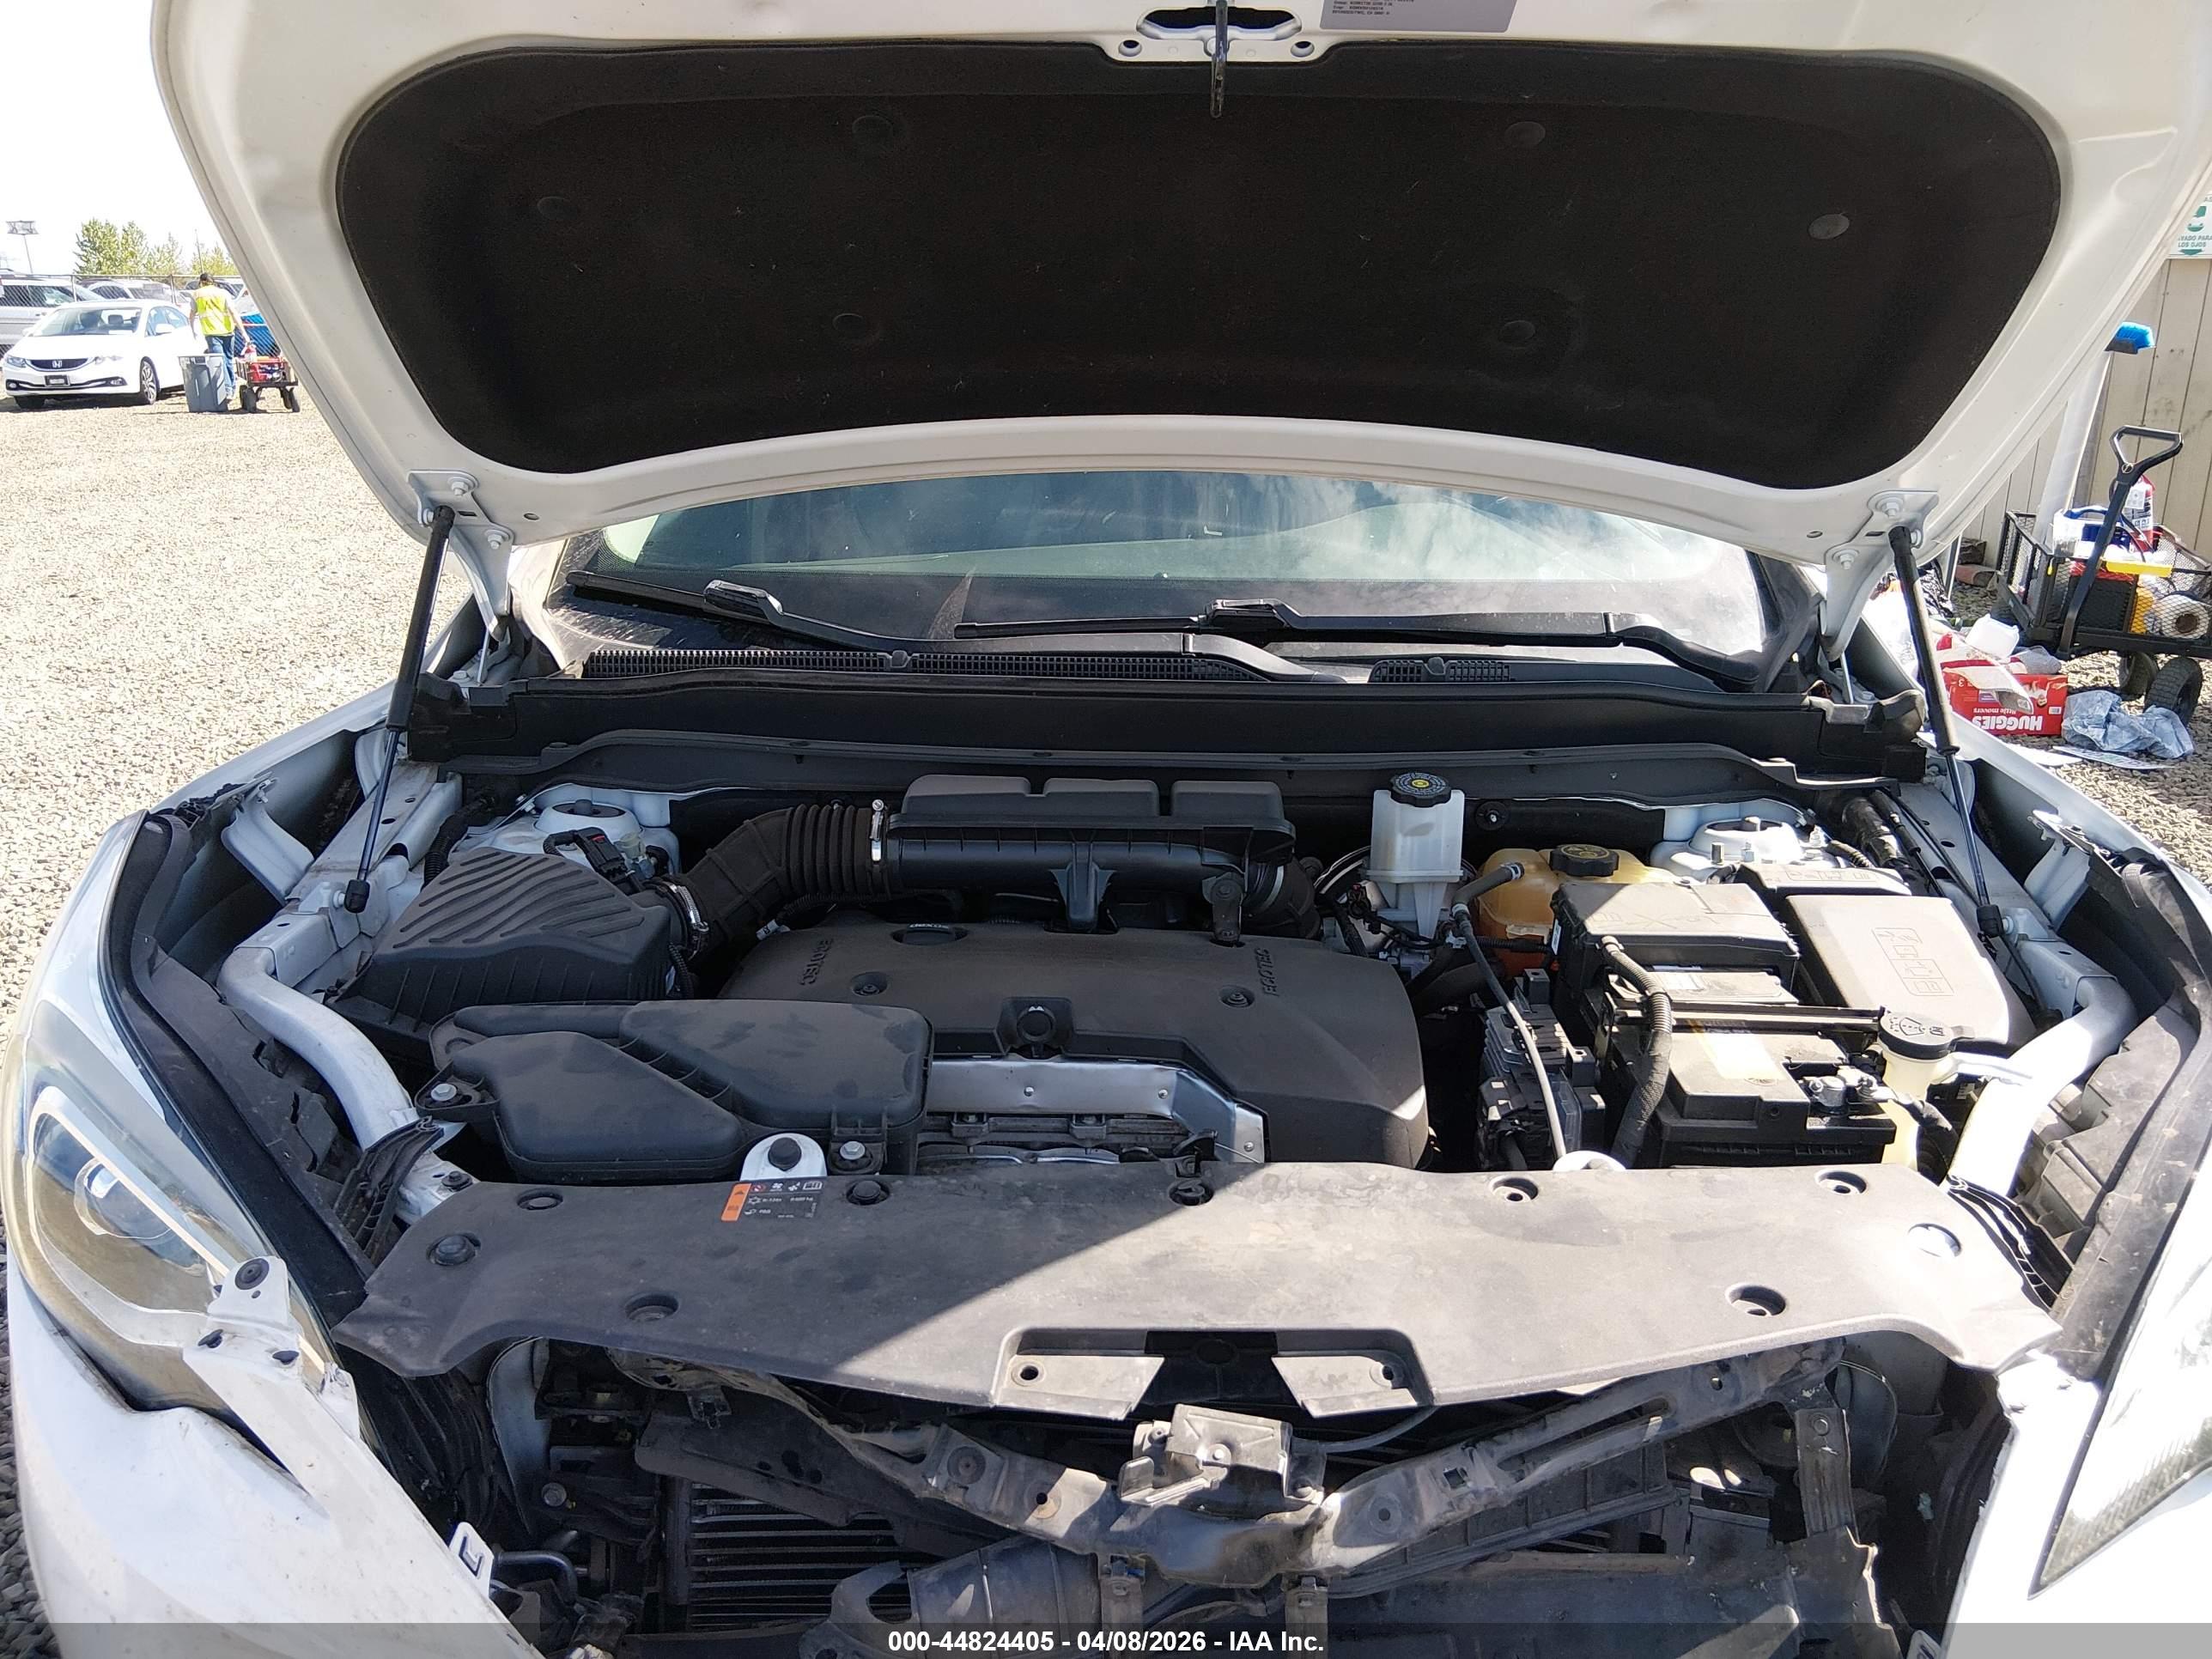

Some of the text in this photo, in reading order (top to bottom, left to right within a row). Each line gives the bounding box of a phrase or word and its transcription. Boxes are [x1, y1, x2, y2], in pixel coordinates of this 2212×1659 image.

[1972, 714, 2044, 731] HUGGIES
[798, 938, 834, 986] ECOTEC
[1253, 947, 1279, 997] ECOTEC
